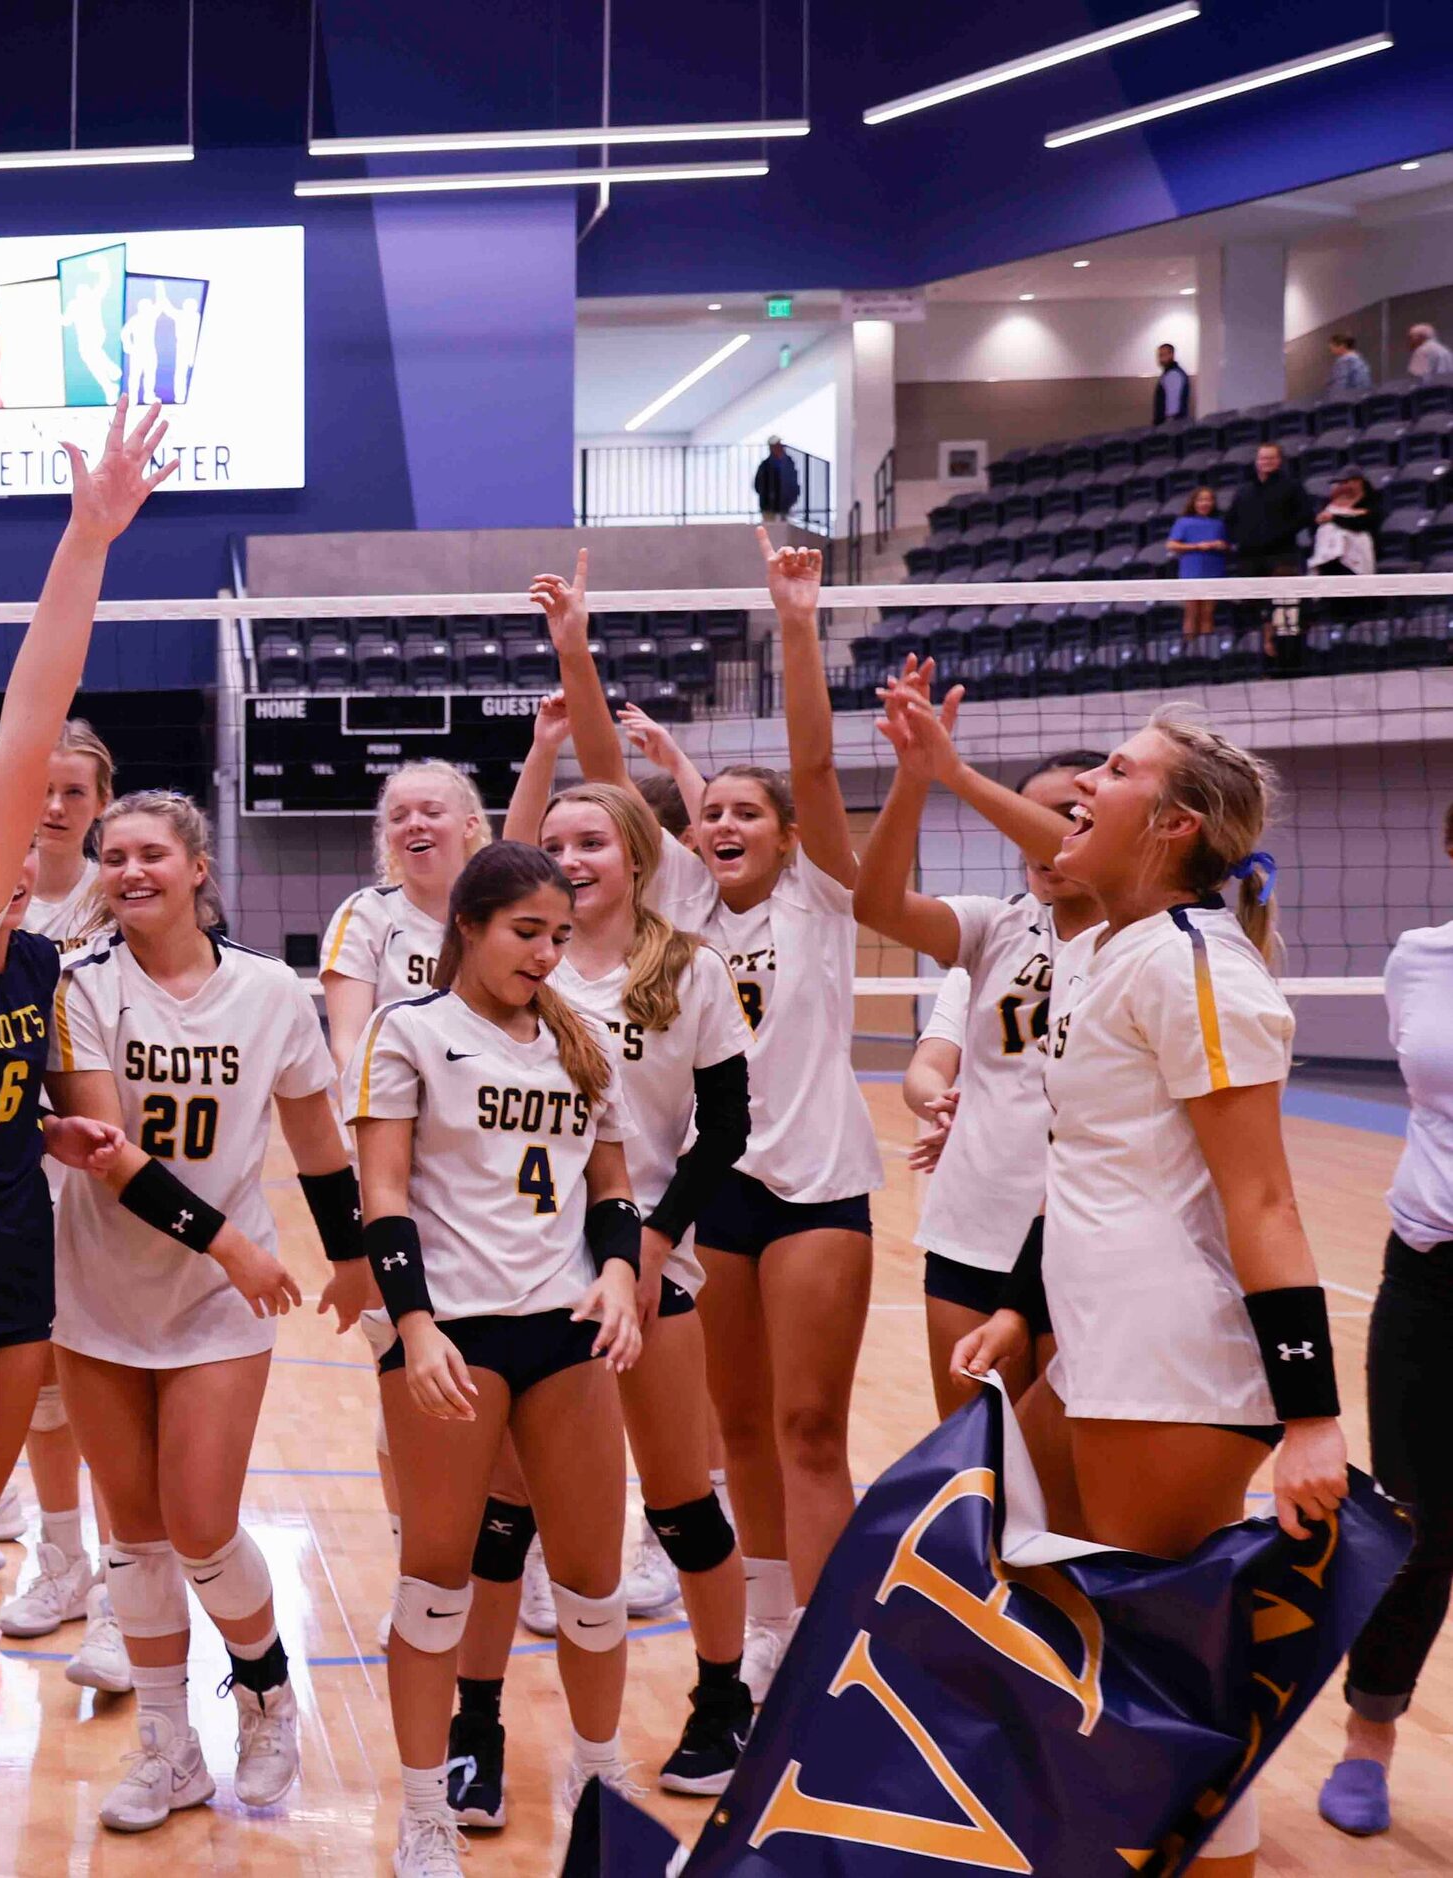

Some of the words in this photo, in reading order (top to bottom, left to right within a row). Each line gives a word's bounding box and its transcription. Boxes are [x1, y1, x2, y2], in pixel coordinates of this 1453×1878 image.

[255, 699, 307, 719] HOME
[481, 696, 539, 717] GUEST
[124, 1039, 240, 1087] SCOTS
[139, 1091, 220, 1162] 20
[476, 1084, 591, 1138] SCOTS
[515, 1142, 562, 1217] 4
